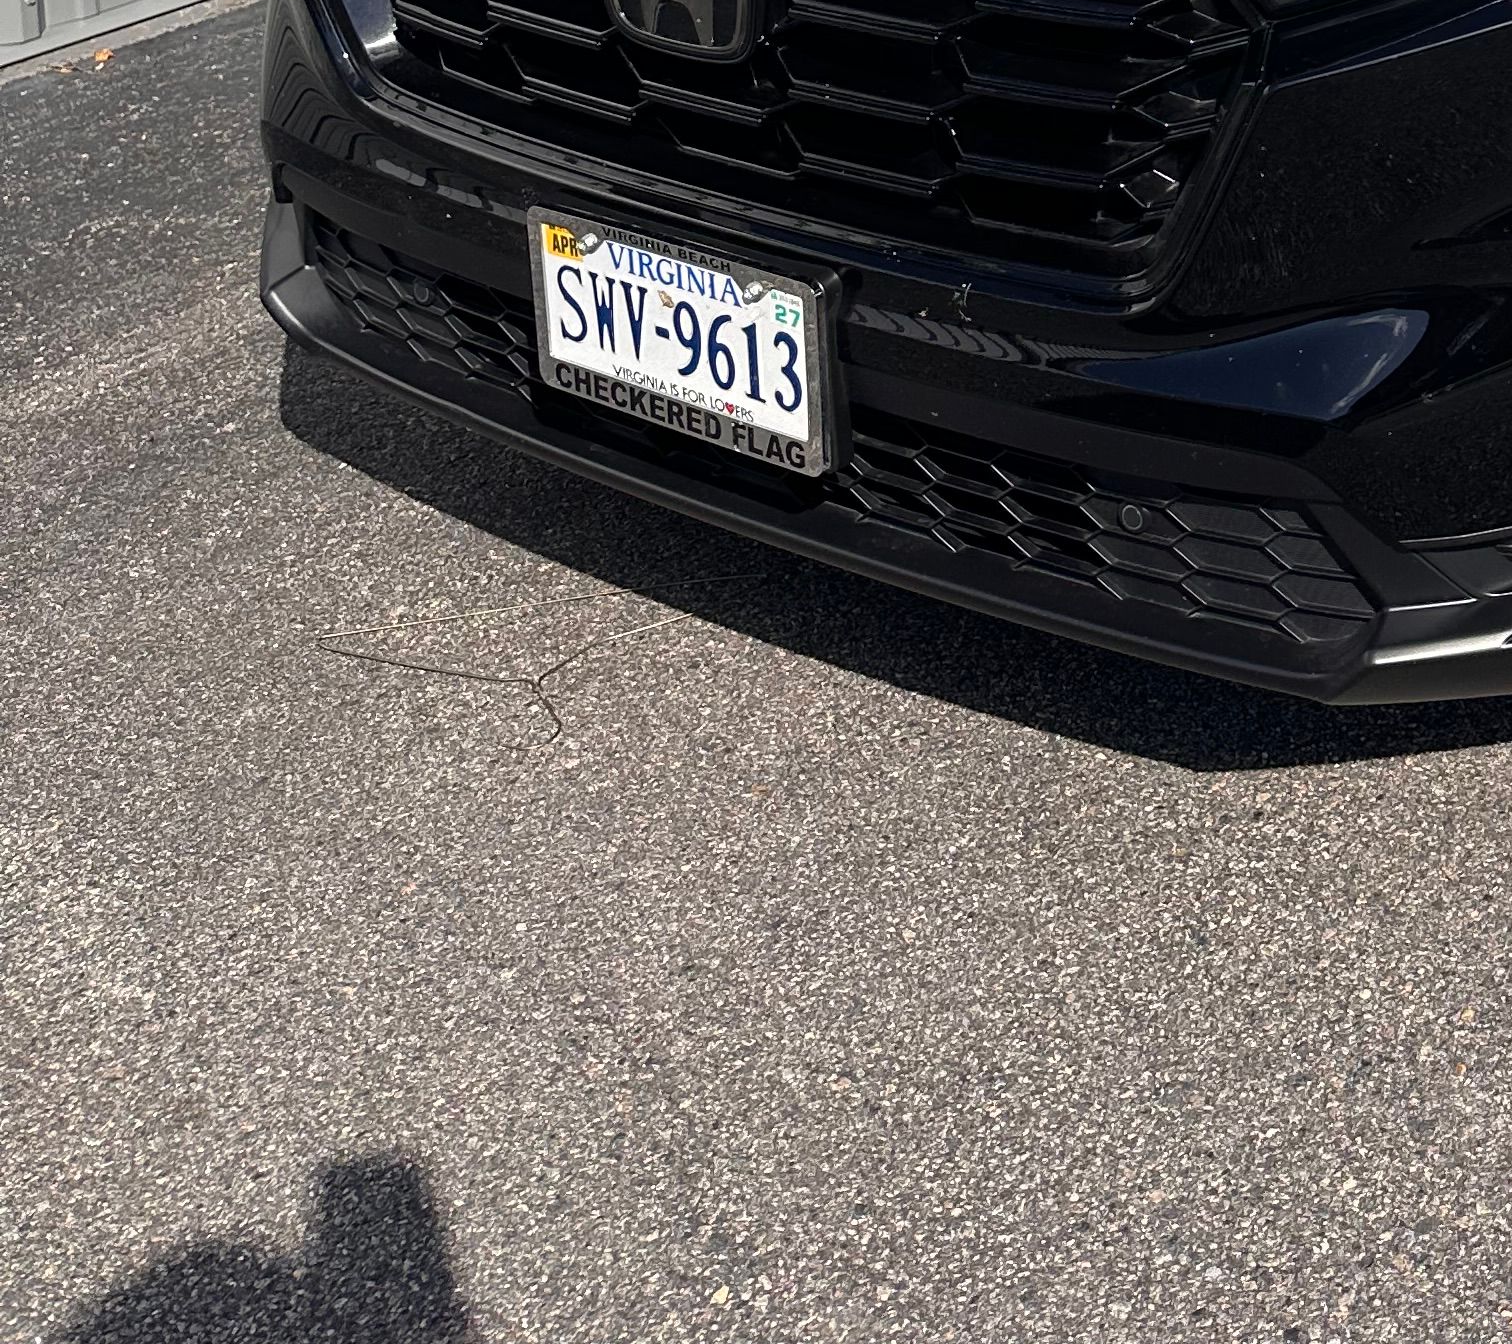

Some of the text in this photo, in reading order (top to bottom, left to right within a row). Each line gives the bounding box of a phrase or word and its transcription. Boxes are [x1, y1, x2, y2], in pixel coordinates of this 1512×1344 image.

[552, 233, 579, 257] APR
[601, 226, 731, 272] VIRGINIA BEACH
[605, 241, 743, 309] VIRGINIA
[556, 264, 803, 413] SWV-9613
[774, 304, 801, 328] 27
[612, 364, 668, 392] VIRGINIA
[670, 382, 680, 397] IS
[682, 386, 707, 407] FOR
[555, 362, 806, 469] CHECKERED FLAG
